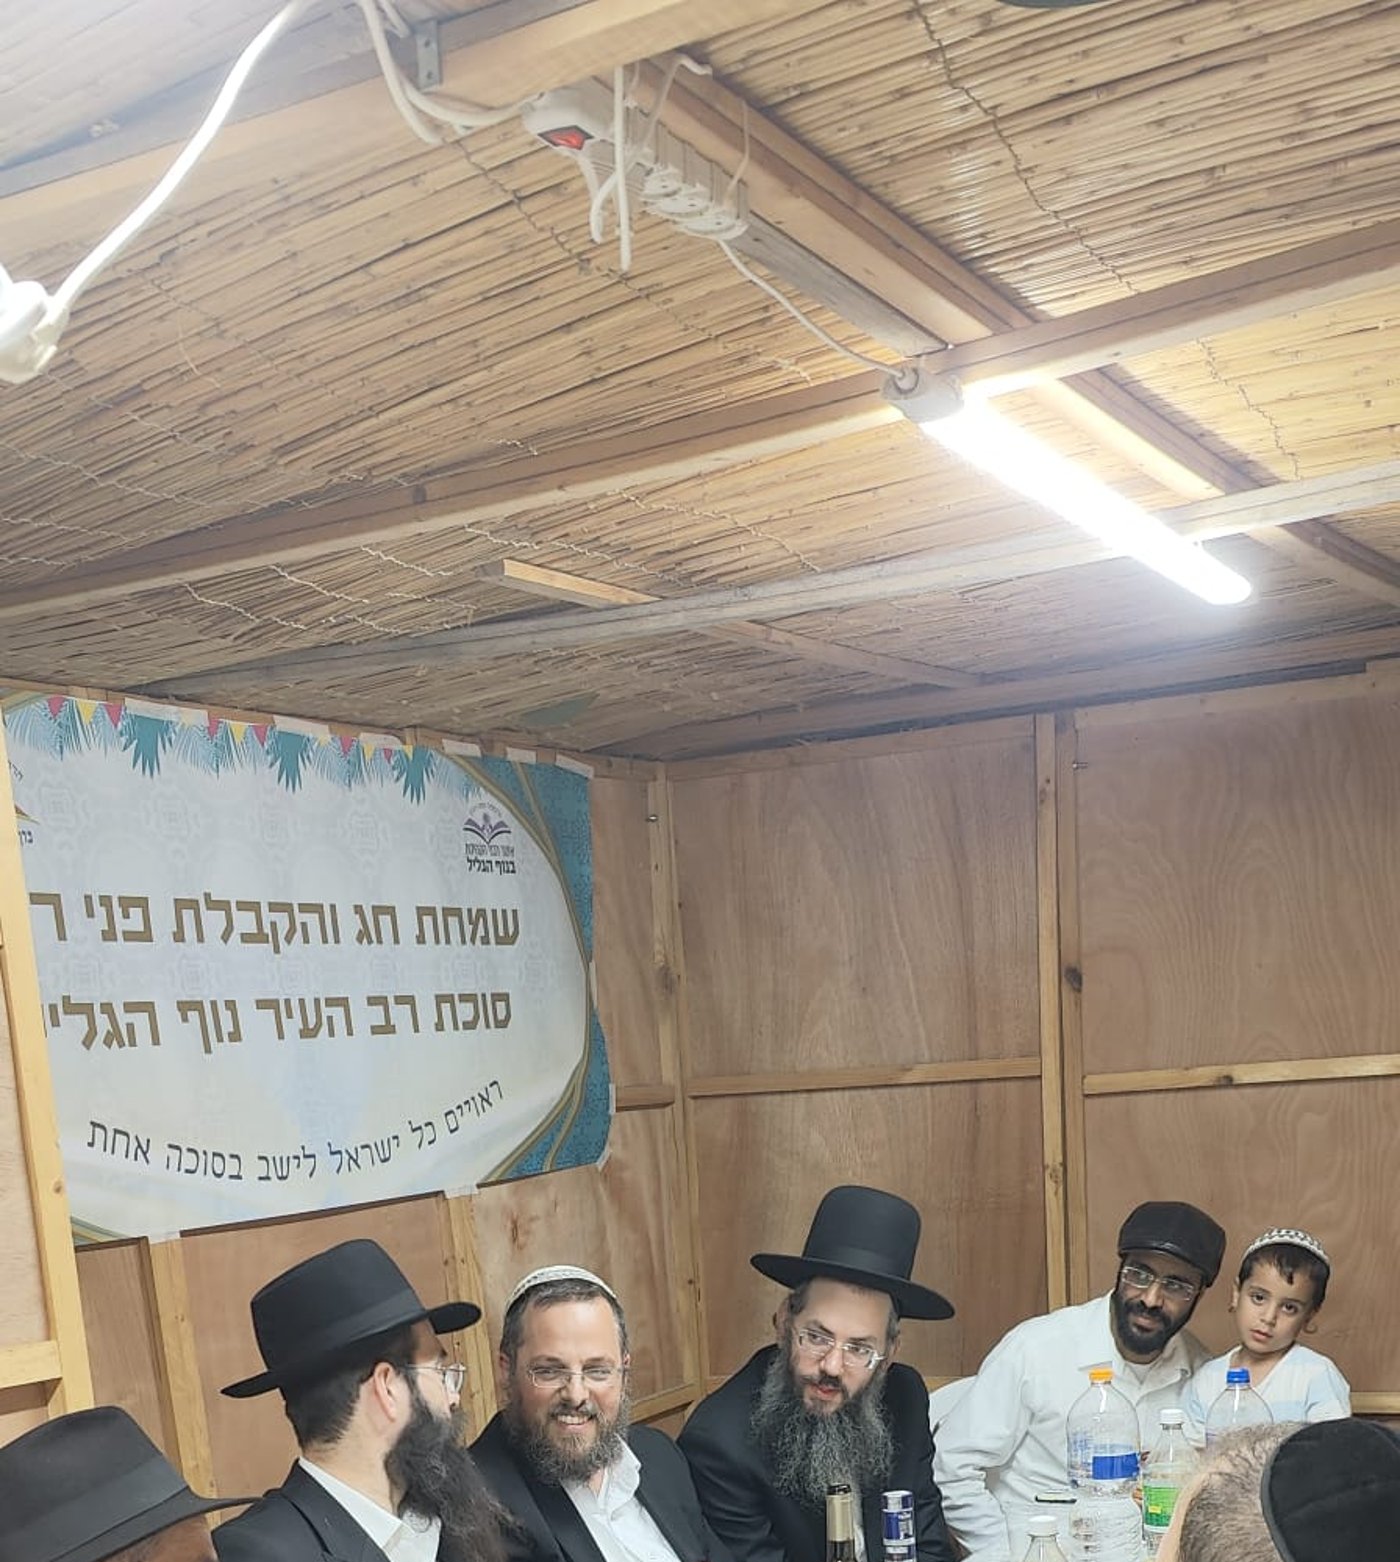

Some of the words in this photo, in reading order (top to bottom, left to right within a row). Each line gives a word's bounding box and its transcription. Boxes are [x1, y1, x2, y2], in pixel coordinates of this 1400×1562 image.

[466, 856, 493, 873] הגליל
[494, 859, 516, 876] בנוף
[83, 894, 153, 943] פני
[172, 892, 341, 954] והקבלת
[353, 904, 401, 945] חג
[416, 906, 520, 945] שמחת
[41, 994, 161, 1051] הגלי
[176, 999, 243, 1054] נוף
[255, 996, 354, 1040] העיר
[366, 995, 420, 1036] רב
[434, 992, 512, 1032] סוכת
[444, 1079, 504, 1134] ראויים
[87, 1120, 151, 1165] אחת
[327, 1134, 400, 1175] ישראל
[408, 1120, 437, 1150] כל
[166, 1143, 243, 1180] בסוכה
[257, 1144, 317, 1181] לישב
